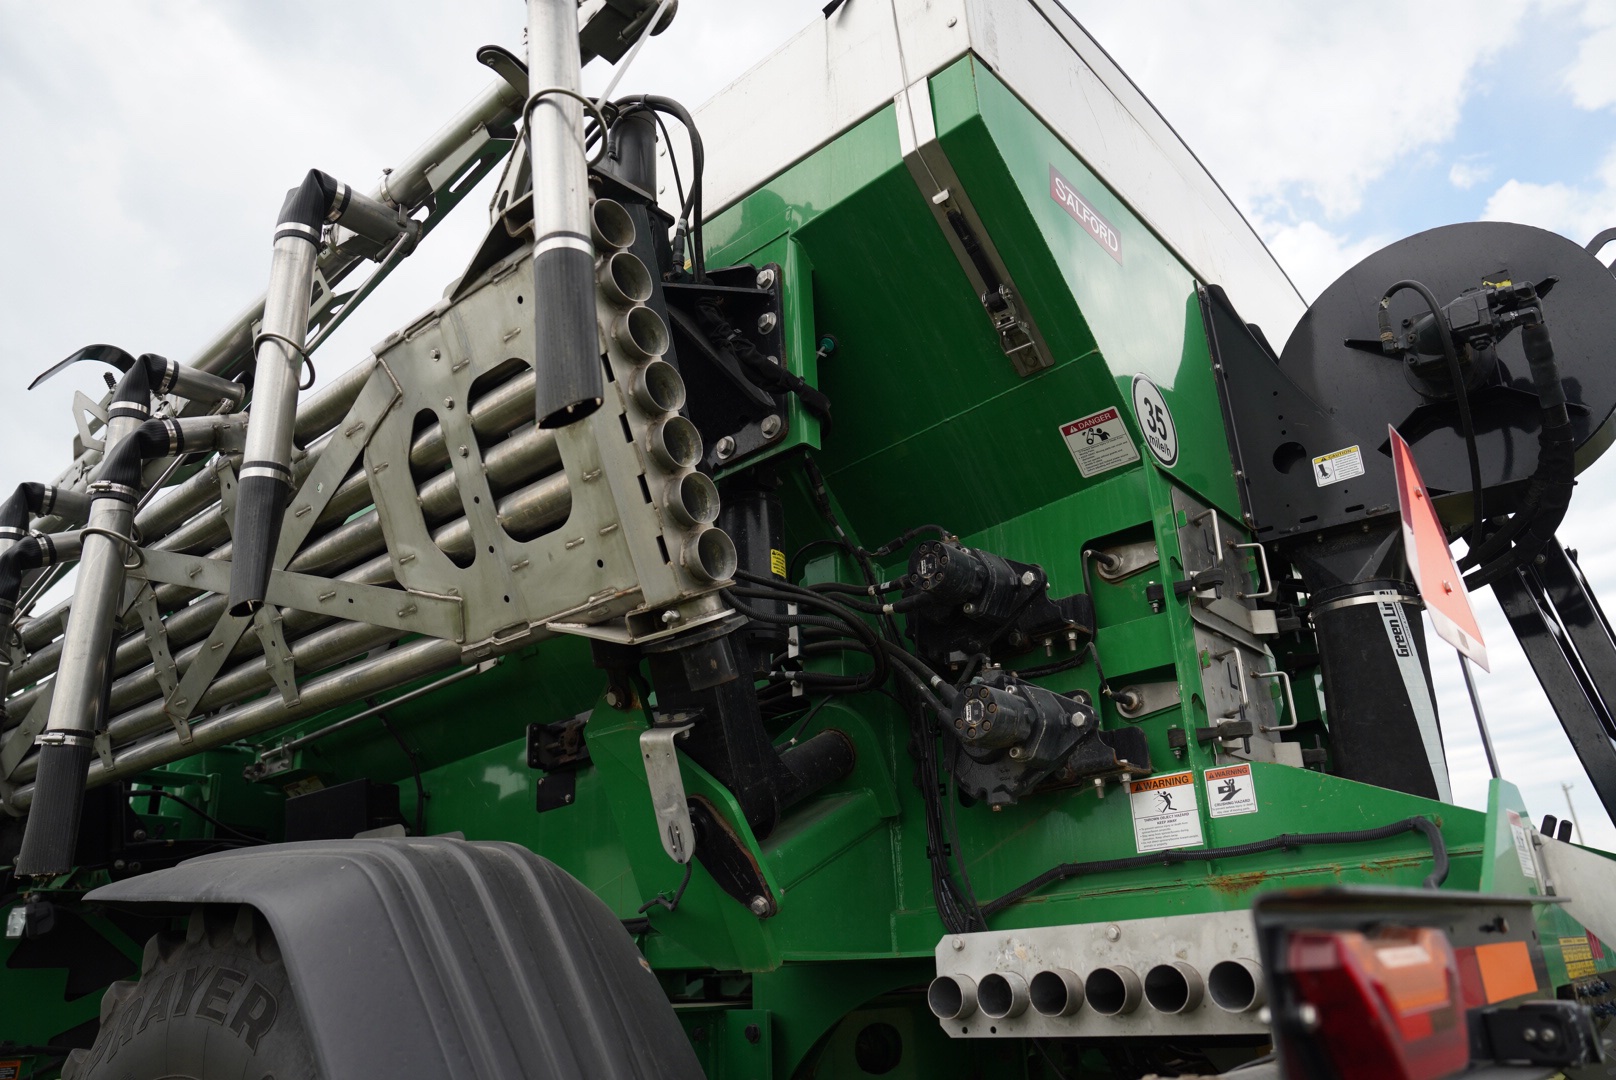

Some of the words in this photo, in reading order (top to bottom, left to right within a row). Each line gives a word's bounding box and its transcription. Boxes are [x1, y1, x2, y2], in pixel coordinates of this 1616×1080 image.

[1055, 177, 1118, 252] SALFORD
[1078, 412, 1112, 430] DANGER
[1143, 397, 1168, 440] 35
[1148, 434, 1172, 458] mile/h
[1328, 448, 1352, 460] CAUTION
[1389, 619, 1410, 657] Green
[1143, 775, 1190, 790] WARNING
[1215, 766, 1248, 778] WARNING
[76, 965, 279, 1080] PRAYER
